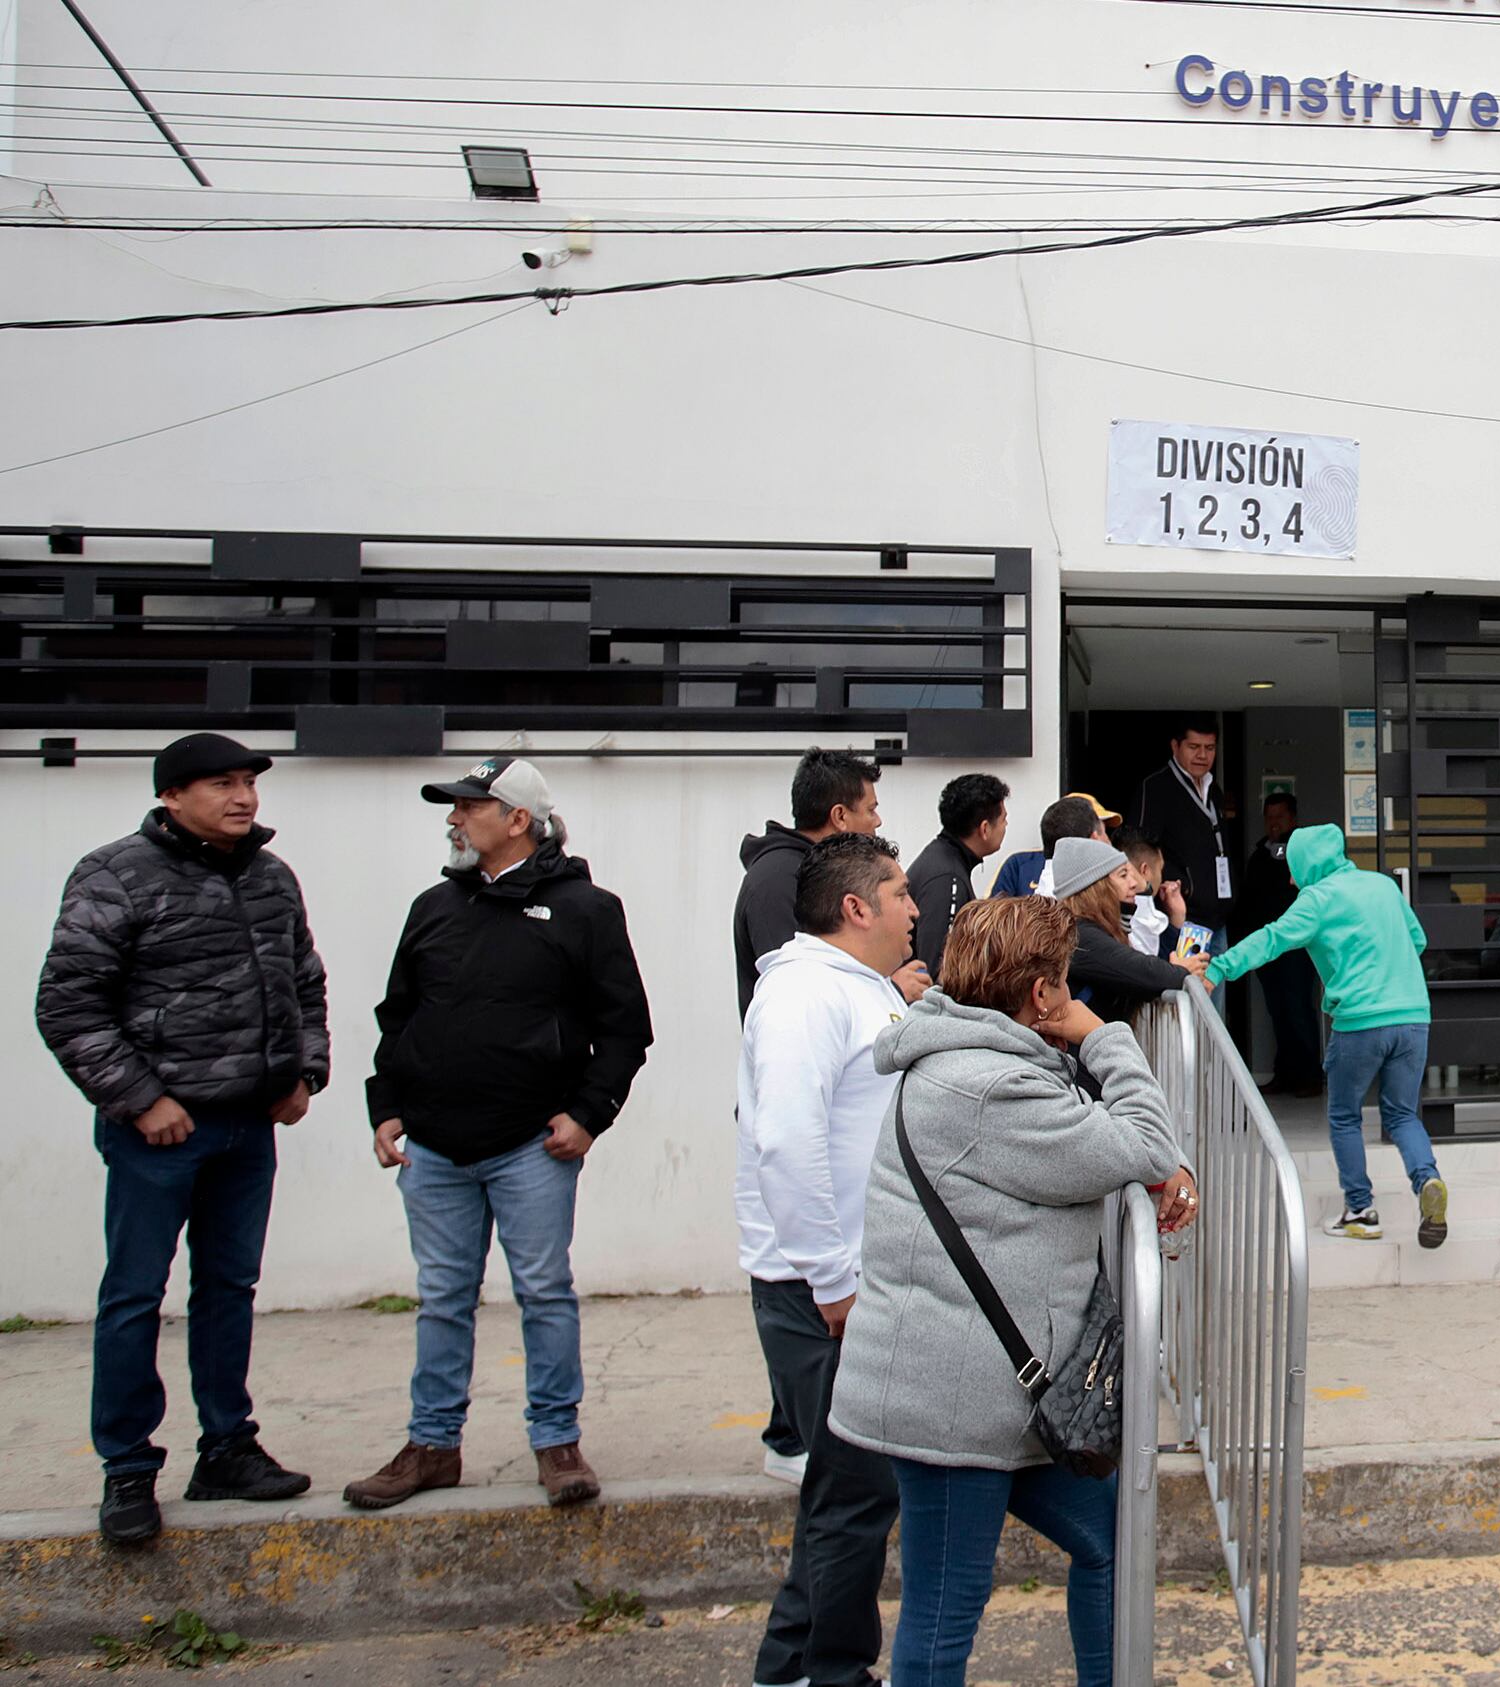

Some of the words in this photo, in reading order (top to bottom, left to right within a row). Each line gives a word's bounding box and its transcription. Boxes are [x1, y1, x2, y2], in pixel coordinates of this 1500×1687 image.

[1156, 436, 1305, 489] DIVISIÓN
[1159, 491, 1186, 541] 1,
[1197, 494, 1228, 543] 2,
[1239, 497, 1272, 546] 3,
[1281, 501, 1304, 544] 4
